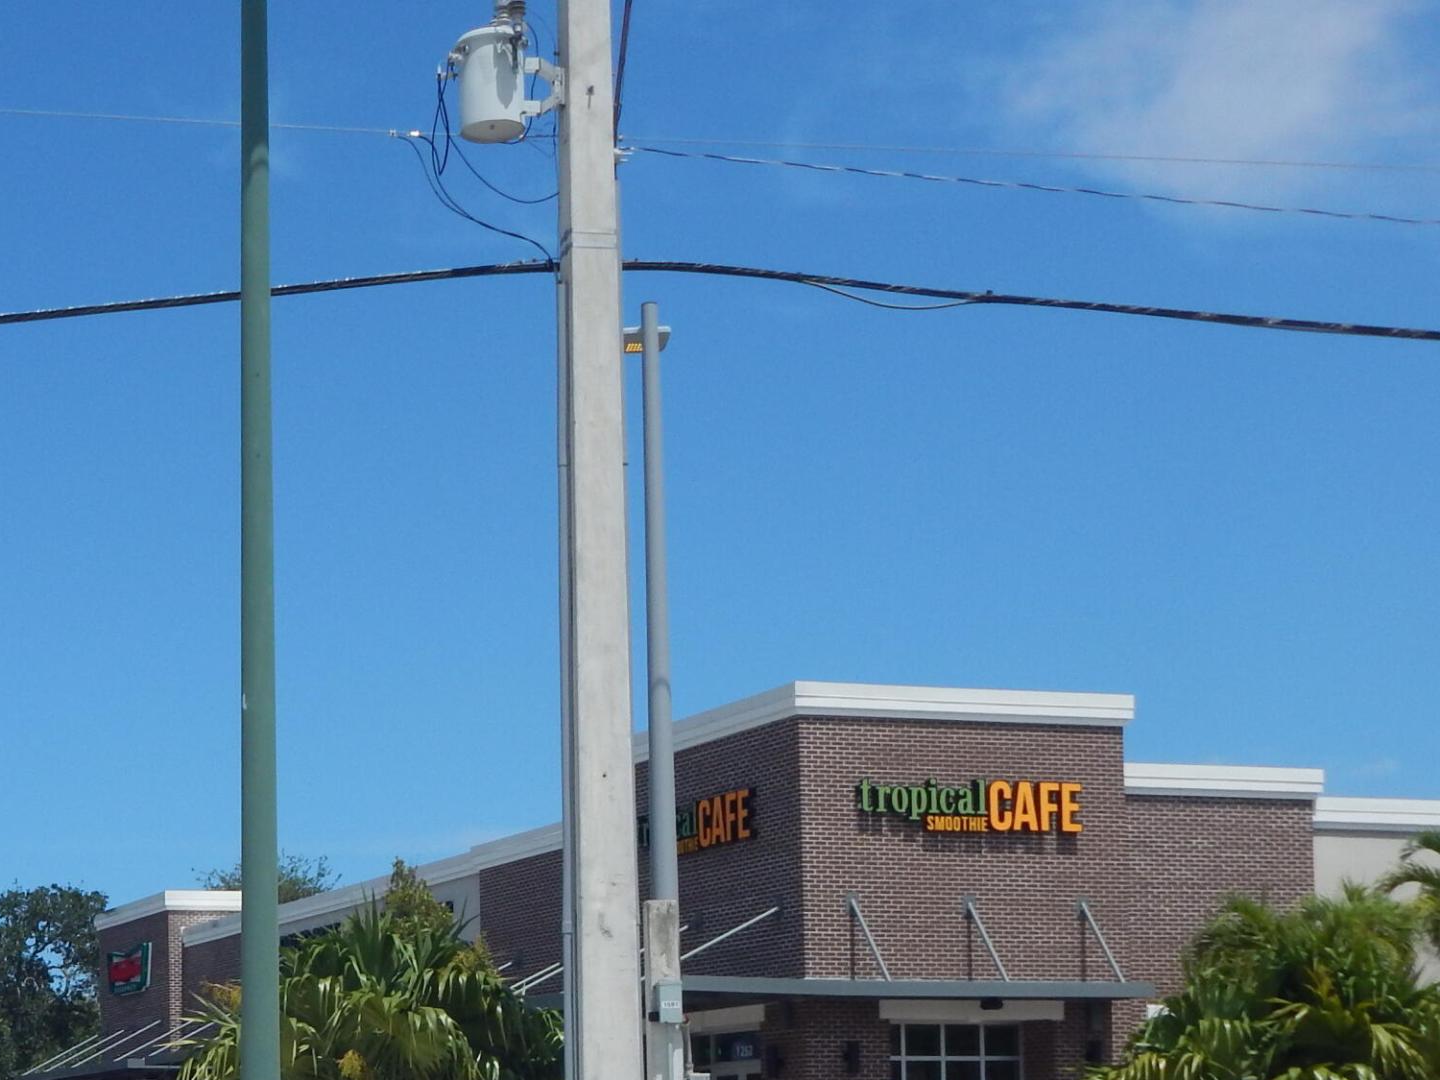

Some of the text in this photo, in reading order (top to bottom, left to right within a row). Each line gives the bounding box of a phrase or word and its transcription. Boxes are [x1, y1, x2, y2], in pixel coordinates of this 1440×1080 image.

[699, 788, 751, 848] CAFE
[860, 778, 1082, 833] tropical CAFE
[925, 815, 989, 834] SMOOTHIE
